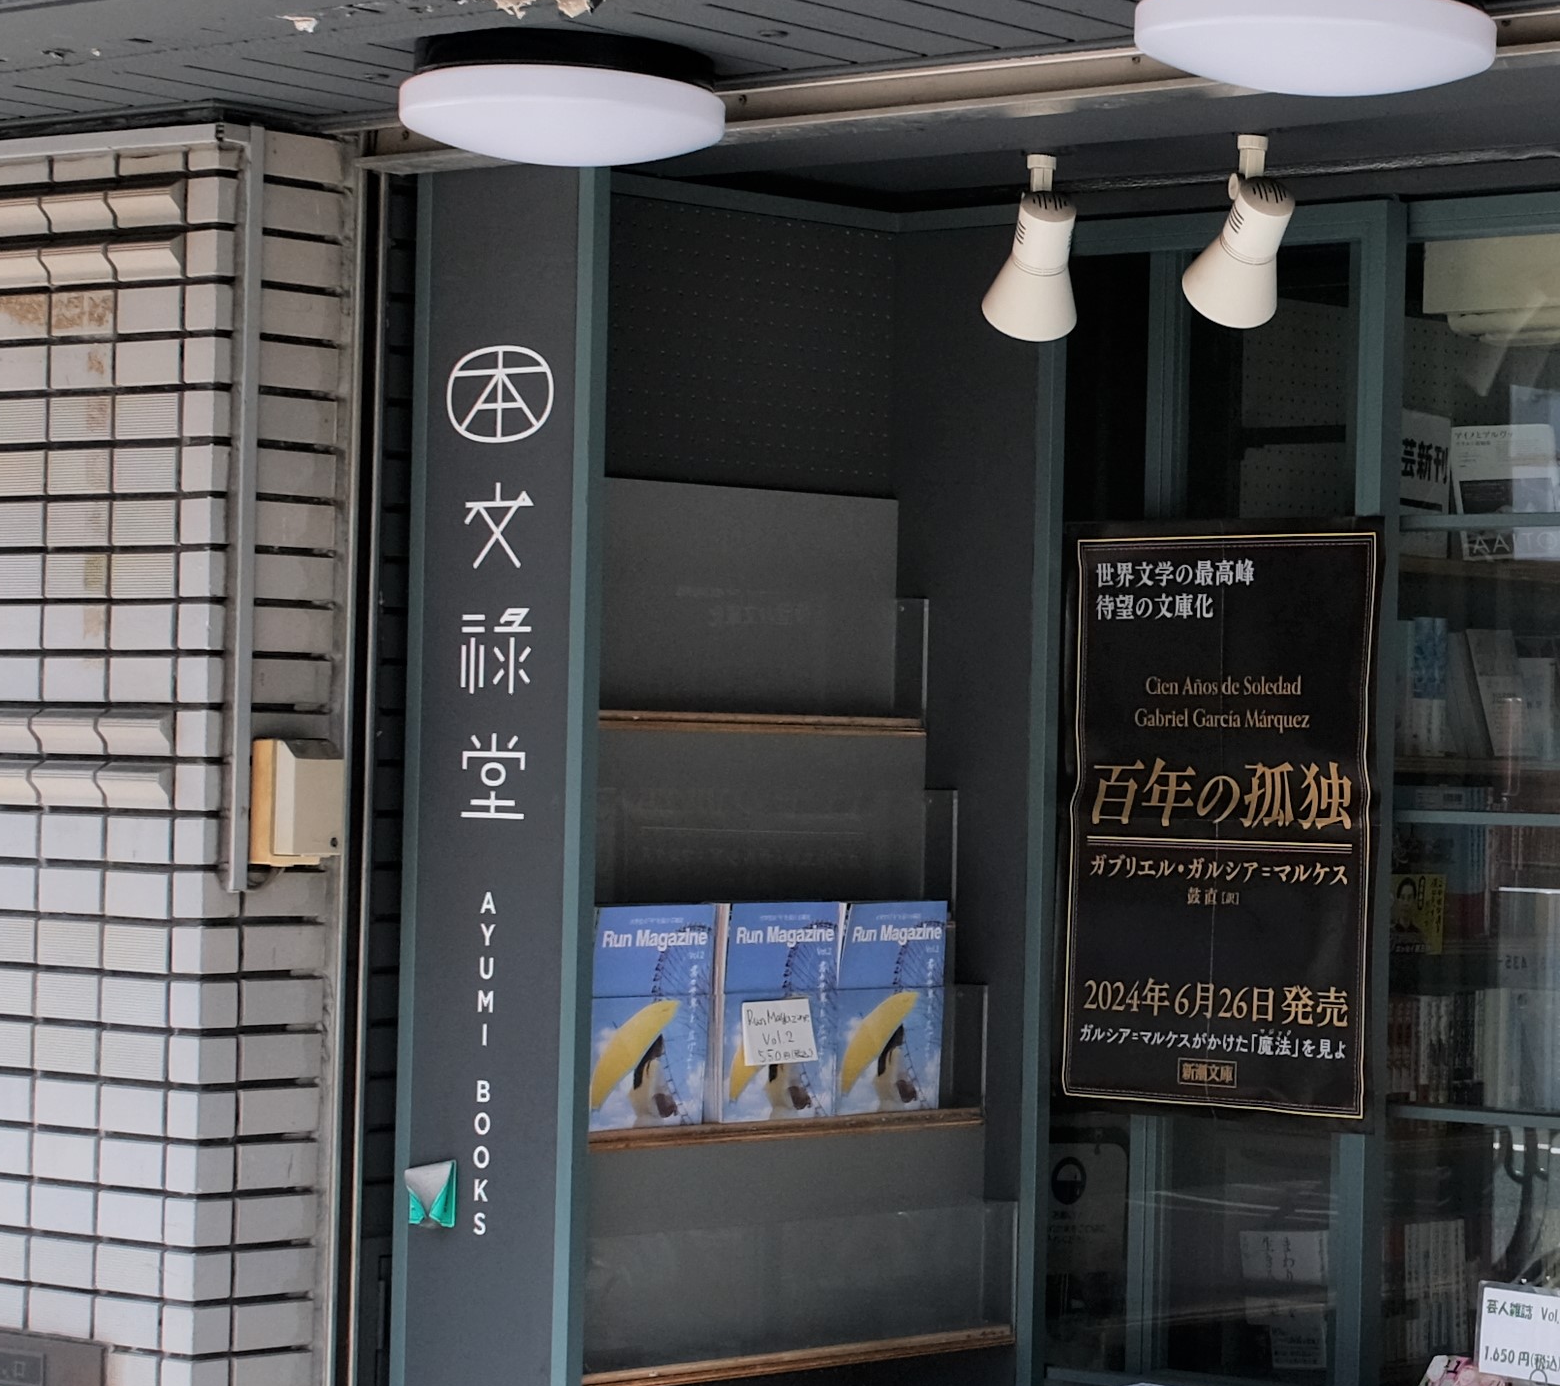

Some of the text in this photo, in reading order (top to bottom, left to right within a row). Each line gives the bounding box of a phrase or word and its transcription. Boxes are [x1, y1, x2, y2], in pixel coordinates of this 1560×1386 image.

[1095, 559, 1255, 590] 世界文学の最高峰
[1095, 593, 1214, 621] 待望の文庫化
[460, 482, 534, 820] 文禄堂
[1145, 674, 1302, 697] Cien Años de Soledad
[1134, 707, 1310, 734] Gabriel García Márquez
[1091, 758, 1353, 832] 百年の孤独
[602, 928, 709, 952] Run Magazine
[736, 925, 835, 948] Run Magazine
[851, 923, 942, 945] Run Magazine
[1083, 977, 1350, 1029] 2024年6月26日発売
[472, 892, 497, 1236] AYUMI BOOKS
[1180, 1062, 1235, 1085] 新潮文庫
